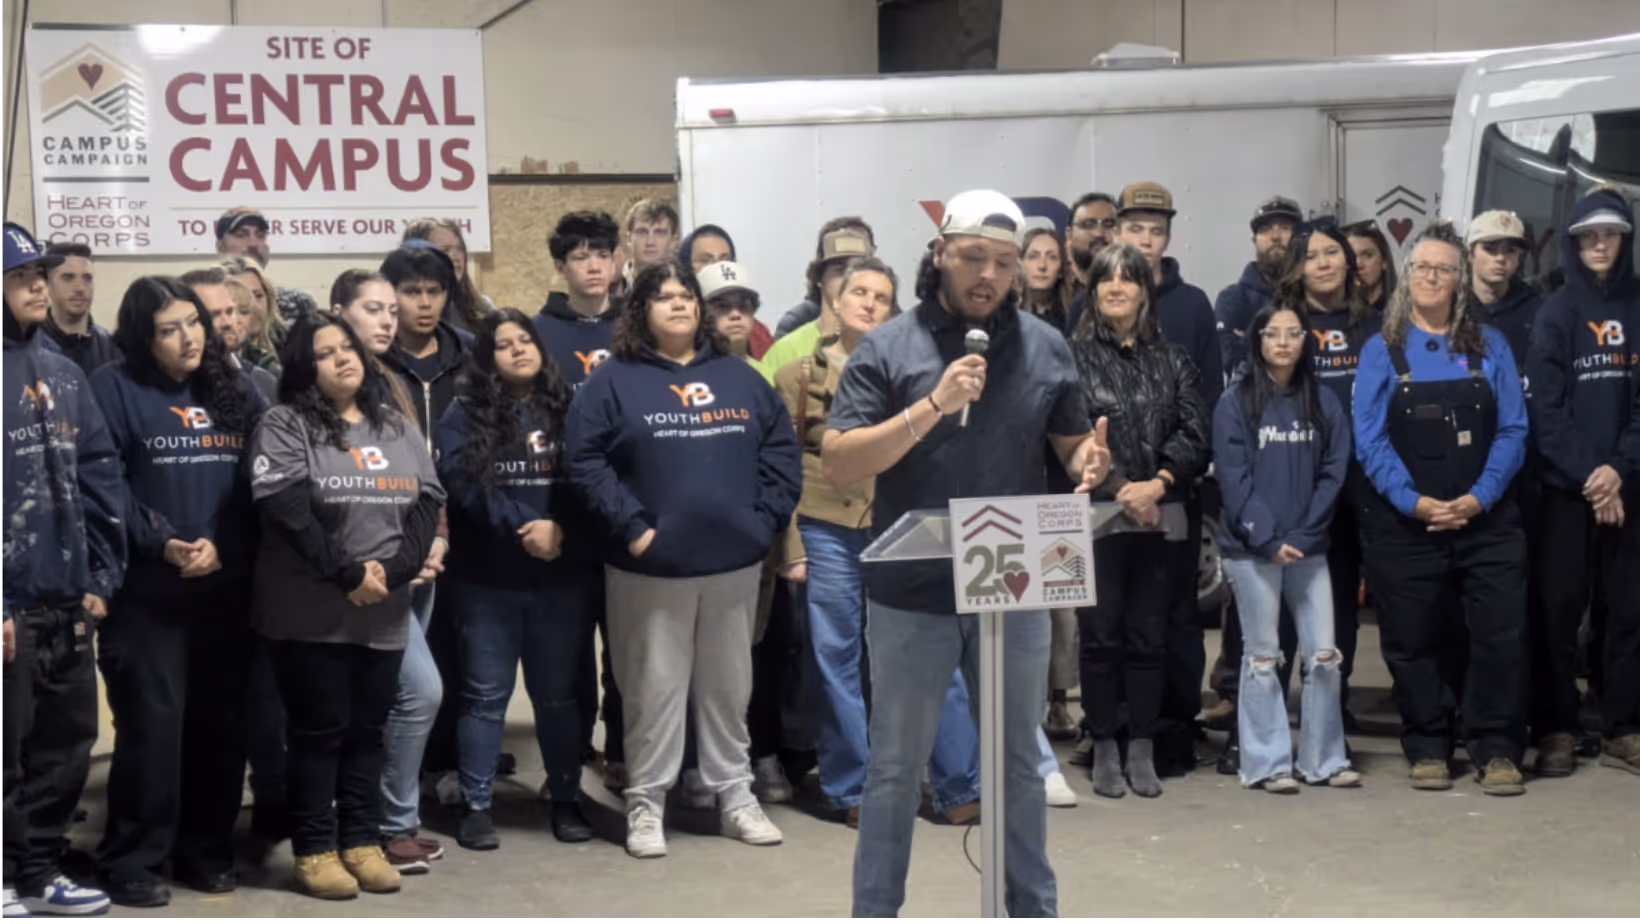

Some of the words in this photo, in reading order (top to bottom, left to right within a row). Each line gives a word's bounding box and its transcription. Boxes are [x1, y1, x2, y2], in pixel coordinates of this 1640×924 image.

[267, 37, 326, 59] SITE
[334, 37, 371, 60] OF
[165, 72, 476, 126] CENTRAL
[43, 136, 147, 151] CAMPUS
[43, 153, 147, 165] CAMPAIGN
[169, 137, 476, 192] CAMPUS
[47, 194, 127, 210] HEART
[128, 200, 148, 210] OF
[48, 213, 150, 229] OREGON
[178, 219, 207, 236] TO
[289, 219, 347, 235] SERVE
[352, 218, 396, 235] OUR
[720, 263, 737, 281] LA
[1588, 320, 1625, 346] YB
[669, 381, 716, 408] YB
[169, 405, 211, 430] YB
[643, 407, 751, 426] YOUTHBUILD
[963, 543, 1027, 597] 25
[966, 596, 1010, 606] YEARS
